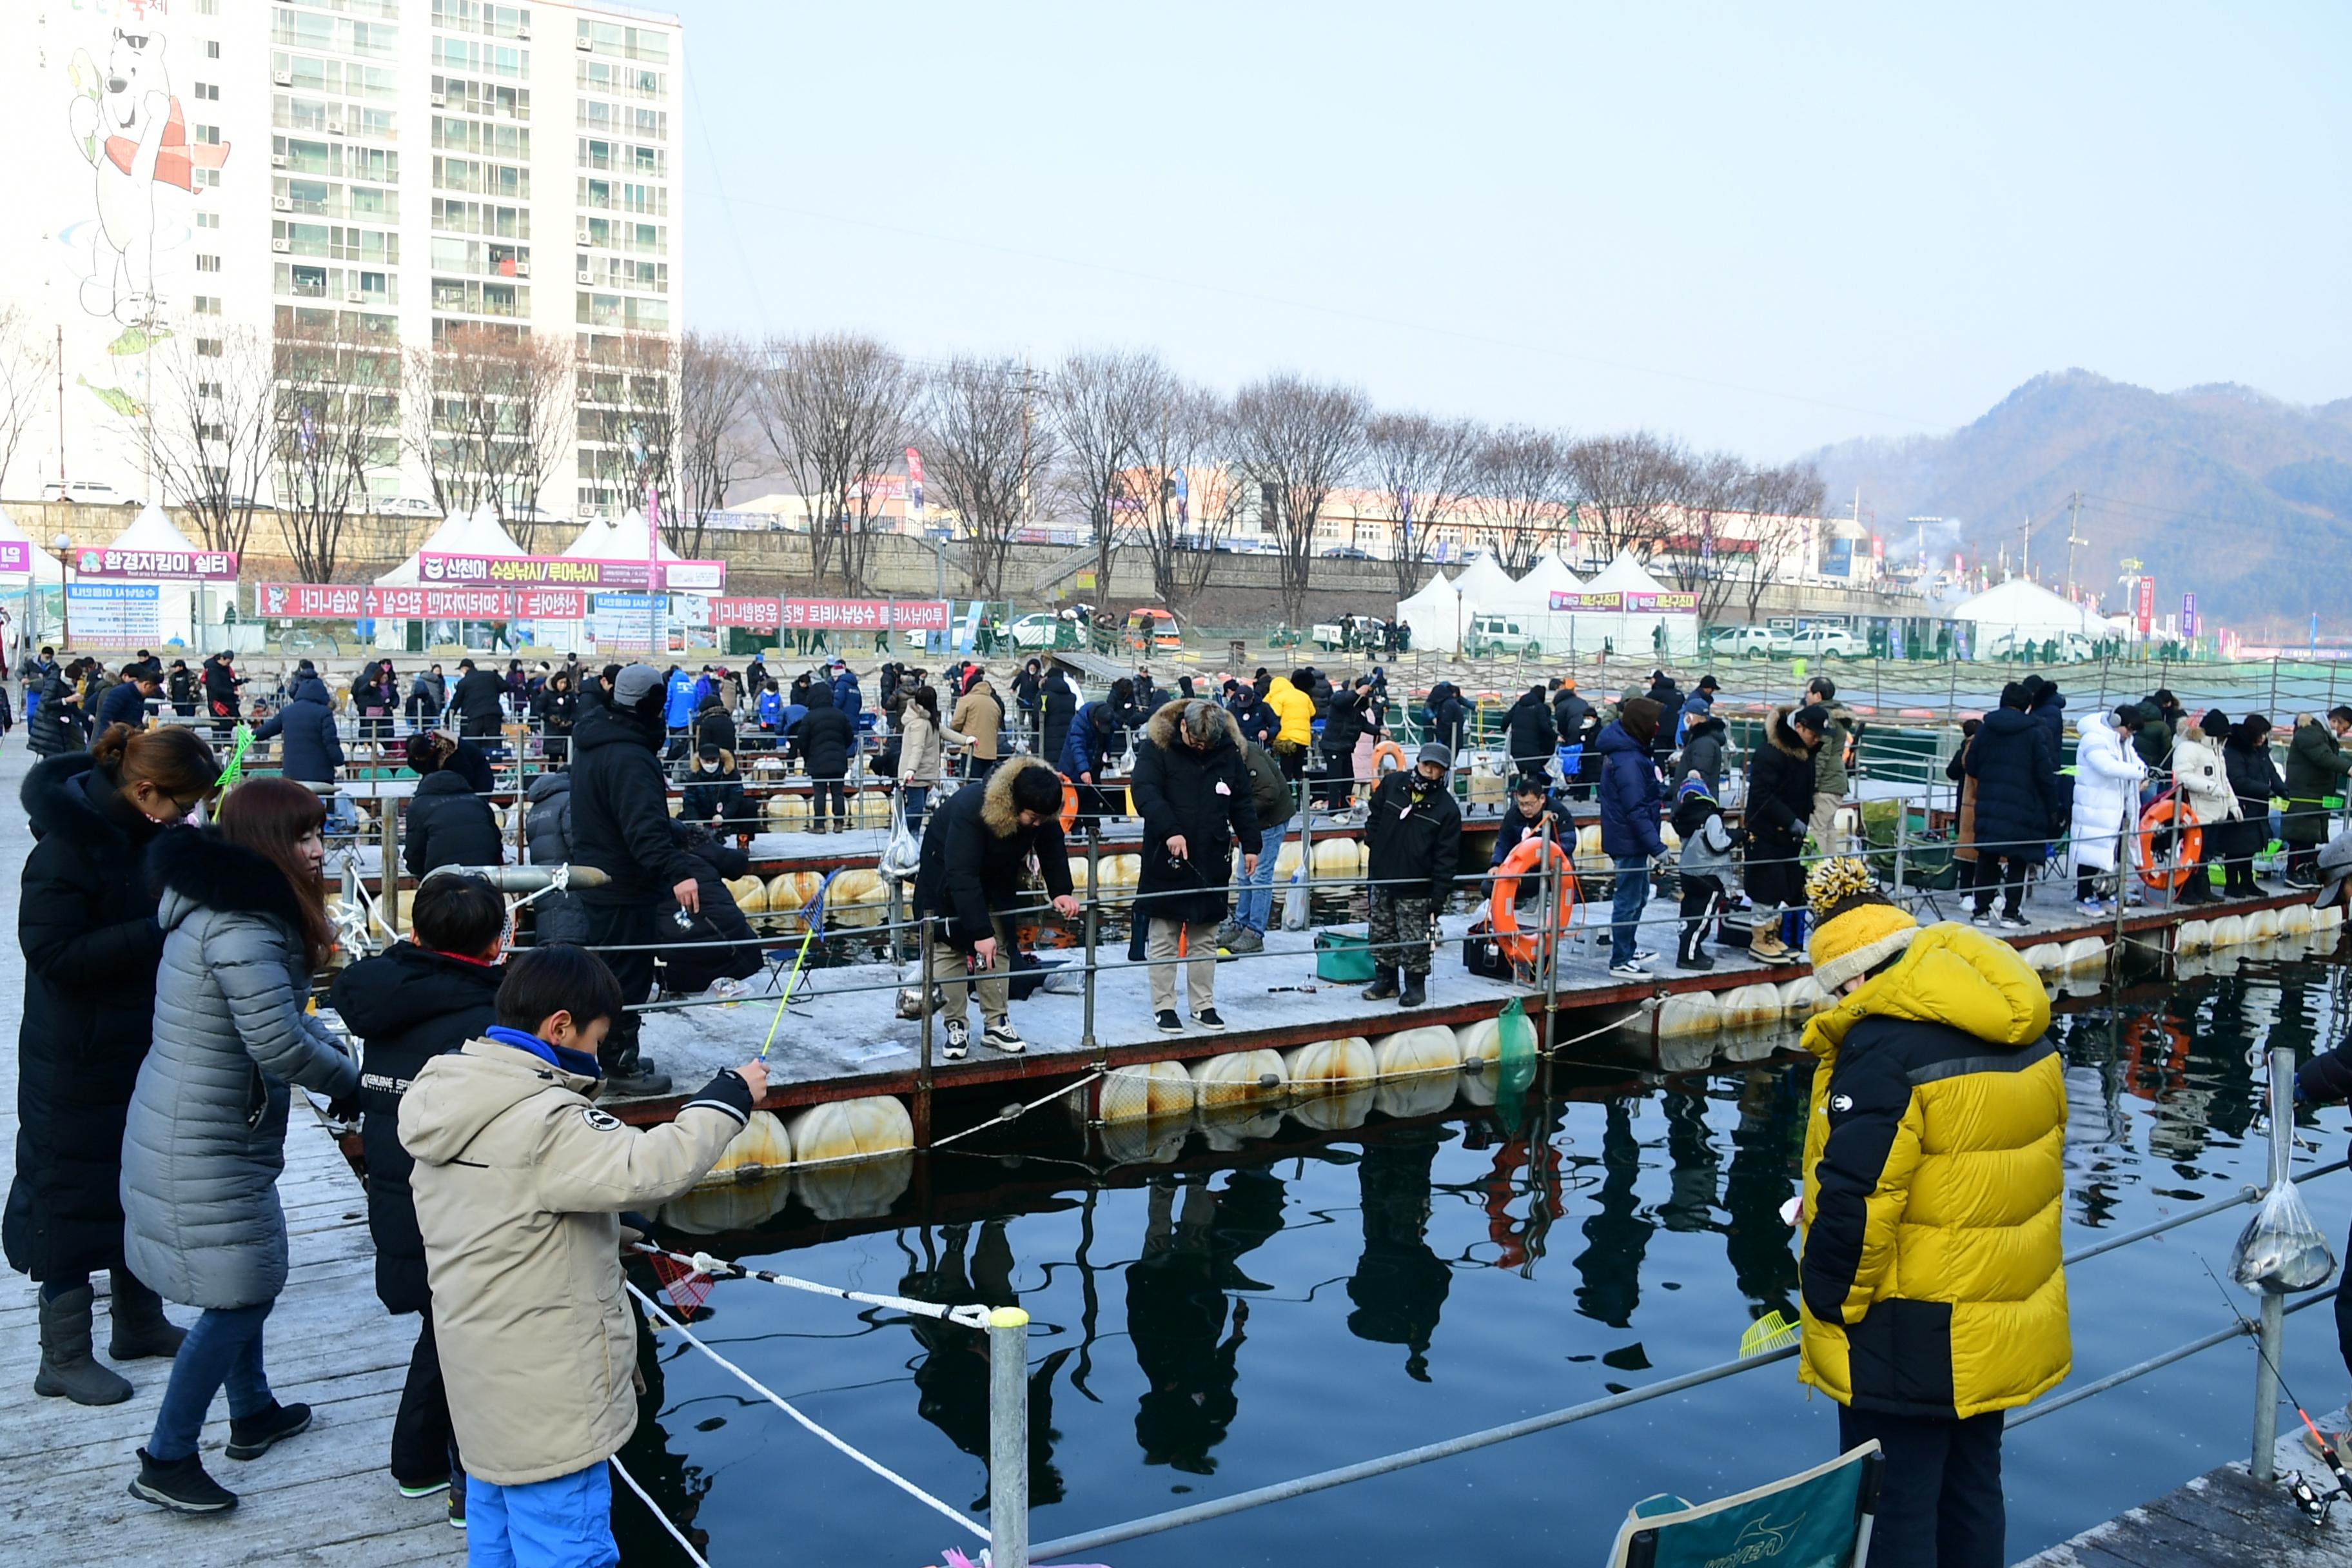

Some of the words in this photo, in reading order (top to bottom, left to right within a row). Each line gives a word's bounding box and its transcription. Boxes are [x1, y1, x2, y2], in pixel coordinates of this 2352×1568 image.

[104, 551, 190, 573] 환경지킴이
[193, 554, 228, 574] 쉼터
[446, 560, 486, 580] 산천어
[489, 563, 598, 583] 수상낚시/루어낚시
